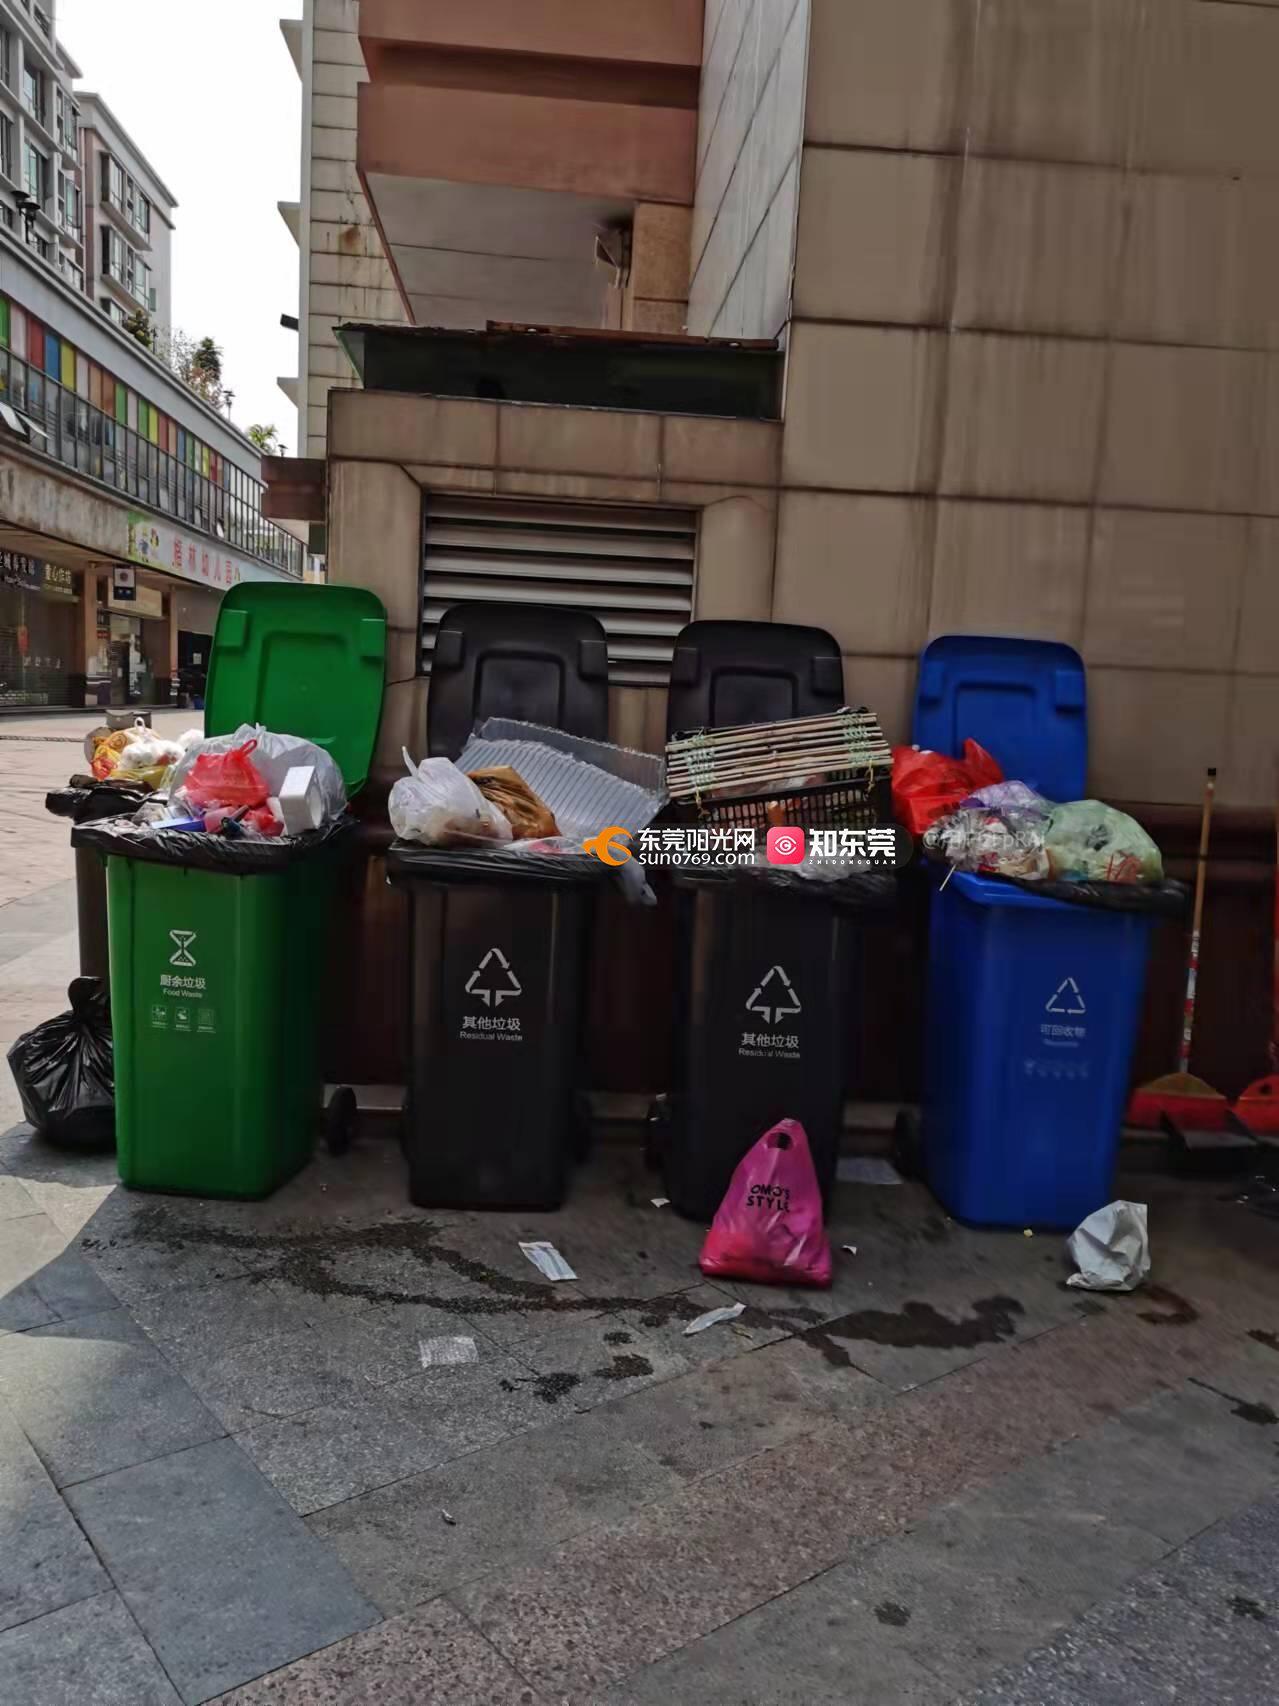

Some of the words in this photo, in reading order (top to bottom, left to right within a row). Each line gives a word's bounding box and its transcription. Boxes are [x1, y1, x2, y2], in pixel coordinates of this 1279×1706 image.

[163, 988, 181, 997] Food
[462, 1015, 521, 1031] 其他垃圾
[459, 1031, 496, 1041] Residual
[497, 1033, 523, 1042] Waste
[741, 1032, 800, 1049] 其他垃圾
[746, 1195, 790, 1213] STYLE
